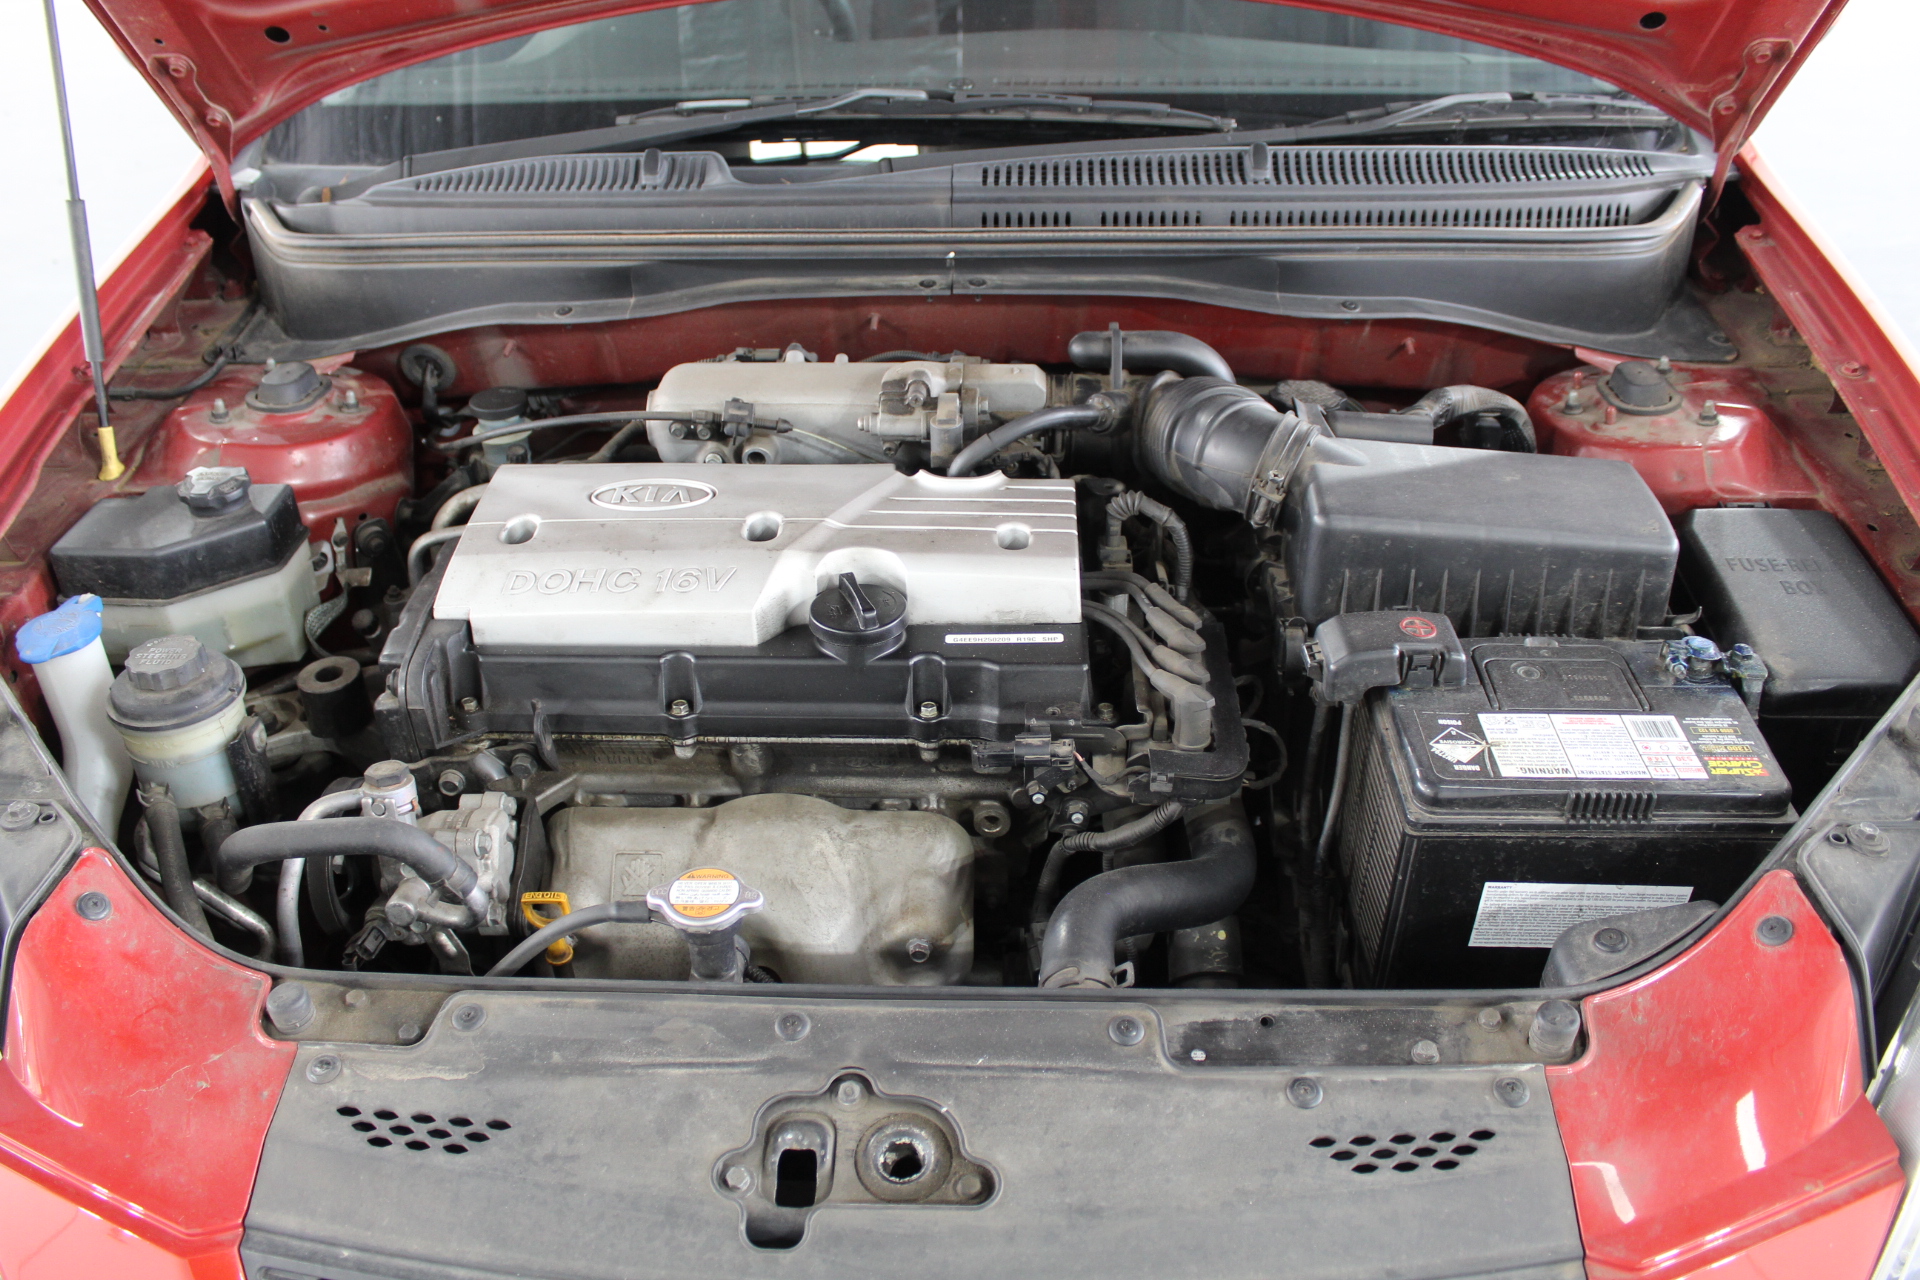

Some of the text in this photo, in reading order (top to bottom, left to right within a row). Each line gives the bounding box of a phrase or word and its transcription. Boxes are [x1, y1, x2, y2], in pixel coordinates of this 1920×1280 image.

[610, 486, 692, 504] KIA
[501, 566, 738, 596] DOHC 16V
[1516, 766, 1572, 775] WARNING:
[1710, 768, 1756, 776] SUPER
